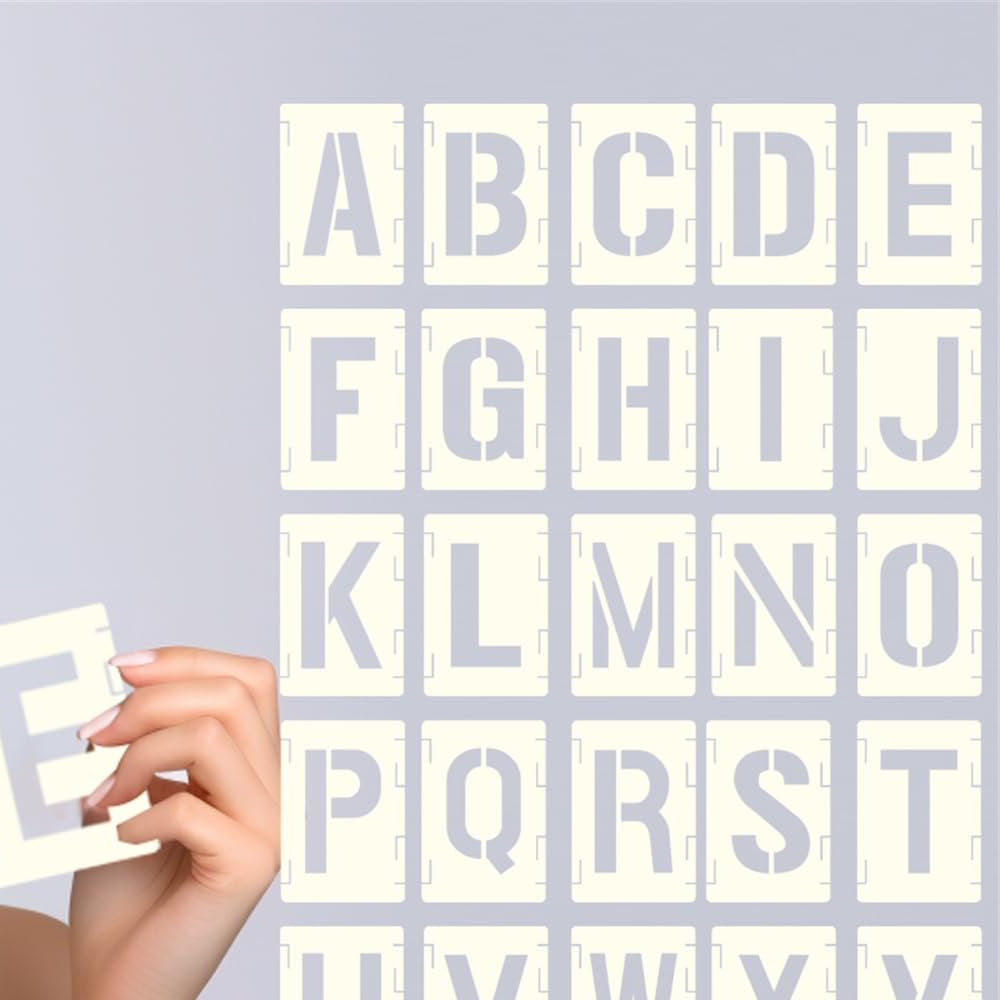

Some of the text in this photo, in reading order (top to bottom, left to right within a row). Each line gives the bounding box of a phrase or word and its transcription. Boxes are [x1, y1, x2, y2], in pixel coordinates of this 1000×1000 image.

[304, 132, 952, 256] A B C D E
[311, 337, 959, 461] F G H I J
[302, 542, 959, 669] K L M N O
[305, 748, 956, 873] P Q R S T
